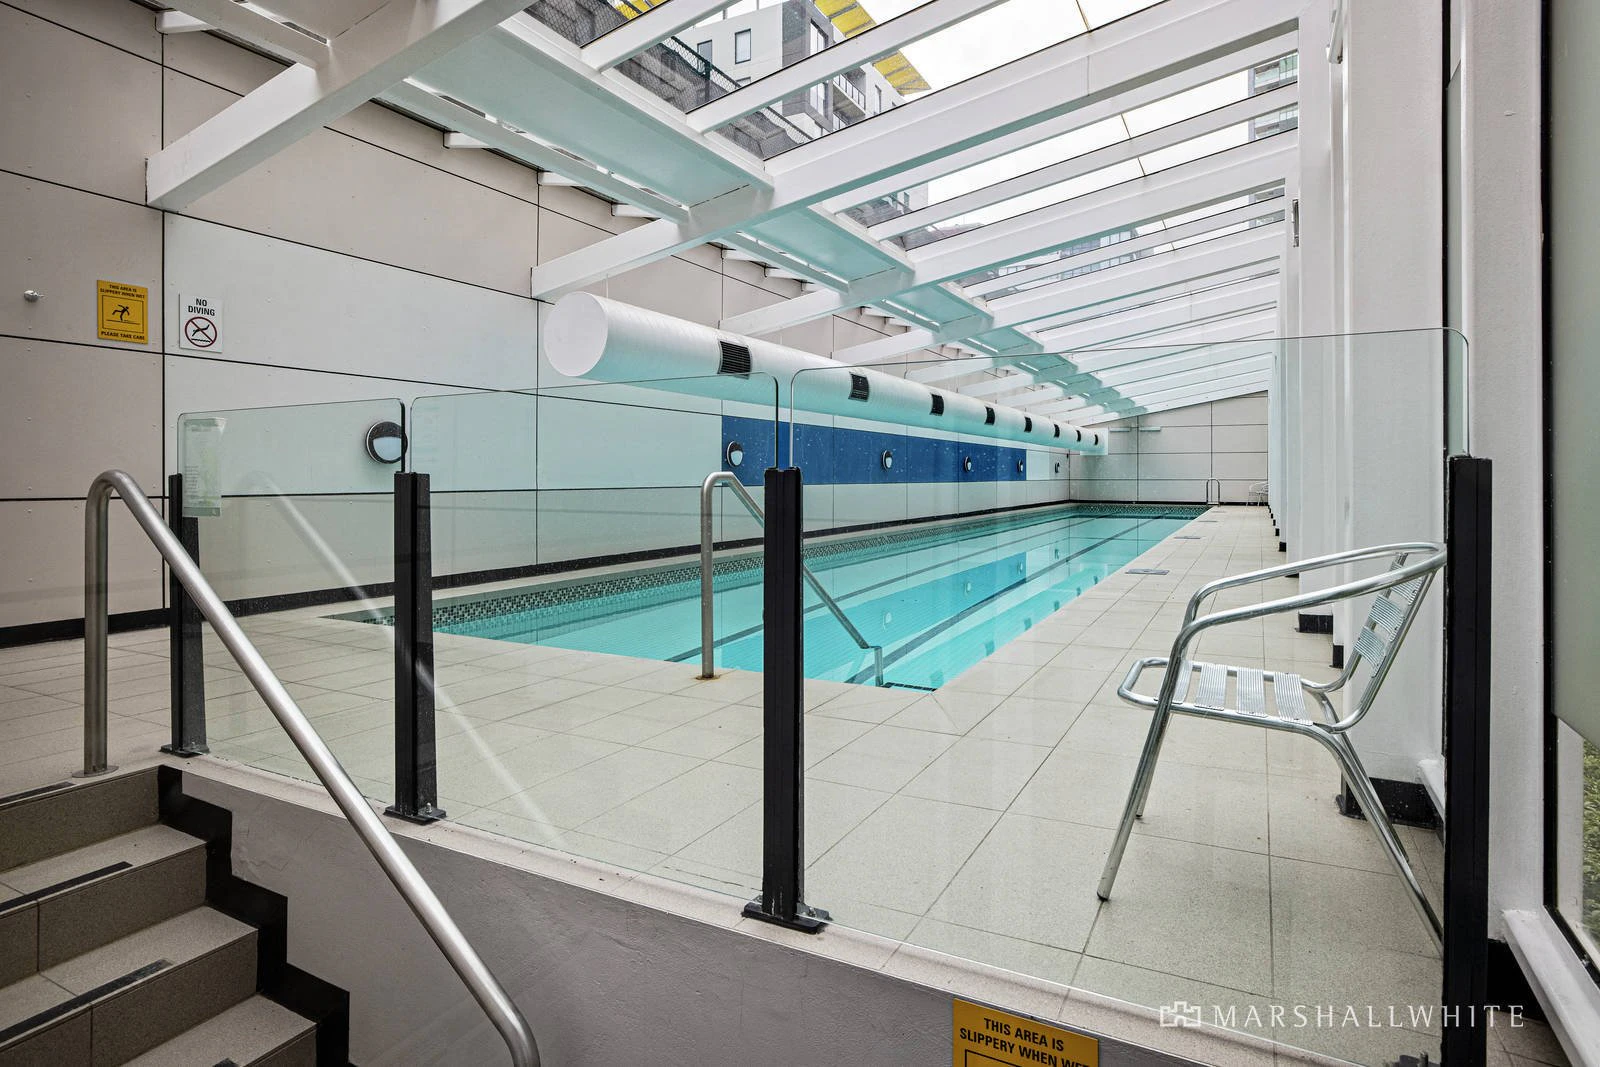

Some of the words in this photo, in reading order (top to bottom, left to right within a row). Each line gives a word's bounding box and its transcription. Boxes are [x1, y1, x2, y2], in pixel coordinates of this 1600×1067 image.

[187, 305, 216, 317] DIVING
[195, 298, 208, 307] NO
[983, 1017, 1012, 1036] THIS
[1014, 1028, 1049, 1048] AREA
[1051, 1037, 1065, 1052] IS
[959, 1027, 1016, 1054] SLIPPERY
[1018, 1045, 1058, 1067] WHEN
